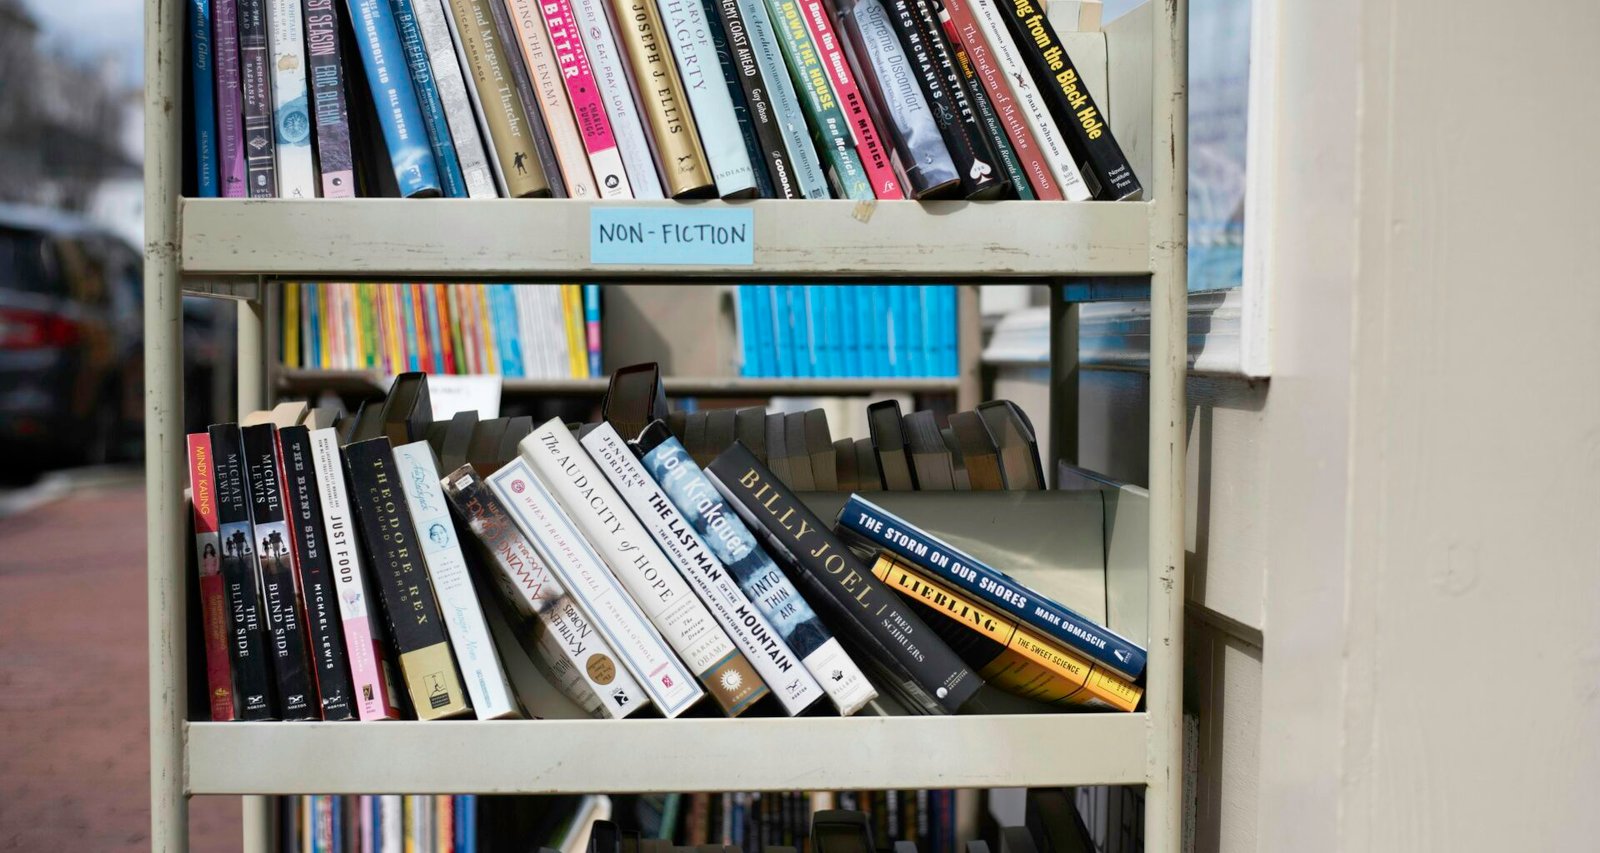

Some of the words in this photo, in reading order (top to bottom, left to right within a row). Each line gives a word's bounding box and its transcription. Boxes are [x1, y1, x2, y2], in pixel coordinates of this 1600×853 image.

[287, 2, 297, 42] WHITAKER
[471, 2, 488, 27] and
[631, 2, 660, 65] JOSEPH
[728, 19, 747, 47] COAST
[962, 22, 980, 44] The
[1023, 11, 1056, 49] from
[307, 14, 336, 56] SEASON
[358, 0, 385, 65] THUNDERBOLT
[376, 66, 389, 84] KID
[398, 13, 430, 85] BATTLEFIELD
[543, 1, 580, 79] BETTER
[594, 42, 609, 64] EAT,
[666, 0, 707, 93] HAGERTY
[694, 27, 709, 49] OF
[752, 13, 775, 61] Armchair
[807, 1, 828, 32] Down
[820, 31, 836, 51] the
[828, 50, 850, 86] House
[195, 42, 208, 70] Glory
[222, 36, 238, 89] RIVER
[466, 36, 487, 82] MARRIAGE
[477, 28, 507, 83] Margaret
[526, 32, 543, 59] THE
[536, 62, 559, 109] ENEMY
[574, 42, 589, 75] FASTER
[737, 46, 756, 77] AHEAD
[781, 0, 806, 41] DOWN
[797, 40, 817, 67] THE
[808, 66, 835, 111] HOUSE
[863, 2, 898, 55] Supreme
[886, 52, 923, 113] Discomfort
[955, 49, 975, 79] Billiards
[971, 44, 1001, 92] Kingdom
[1041, 44, 1069, 73] the
[254, 55, 265, 98] NICHOLAS
[313, 64, 338, 87] ERIC
[601, 65, 618, 93] PRAY,
[651, 68, 666, 83] J.
[749, 87, 764, 102] Guy
[928, 28, 951, 69] FIFTH
[947, 73, 975, 125] STREET
[968, 78, 980, 93] The
[1053, 66, 1090, 110] Black
[315, 90, 341, 126] BLEHM
[386, 88, 400, 107] BILL
[496, 83, 525, 139] Thatcher
[611, 94, 625, 118] LOVE
[657, 86, 682, 135] ELLIS
[755, 100, 770, 124] Gibson
[973, 91, 992, 117] Official
[996, 90, 1009, 103] of
[391, 107, 409, 141] BRYSON
[578, 105, 595, 137] DUHIGG
[587, 100, 605, 136] CHARLES
[845, 91, 862, 116] BEN
[856, 117, 885, 170] MEZRICH
[985, 116, 1000, 136] Rules
[1002, 104, 1030, 149] Matthias
[1024, 91, 1039, 112] Paul
[1038, 120, 1062, 157] Johnson
[1074, 104, 1108, 142] Hole
[825, 116, 841, 136] Ben
[833, 136, 857, 177] Mezrich
[994, 134, 1006, 149] and
[715, 164, 752, 180] INDIANA
[798, 148, 815, 183] CHRISTENSEN
[1000, 147, 1018, 175] Records
[1030, 159, 1050, 190] OXFORD
[1107, 163, 1126, 177] Naval
[1109, 170, 1131, 184] Institute
[1012, 173, 1026, 192] Book
[1115, 177, 1131, 189] Press
[599, 222, 746, 245] NON-FICTION
[195, 445, 207, 477] MINDY
[291, 442, 303, 471] THE
[597, 445, 635, 489] JORDAN
[601, 434, 647, 488] JENNIFER
[197, 478, 210, 515] KALING
[216, 464, 230, 503] LEWIS
[226, 453, 243, 511] MICHAEL
[251, 464, 265, 503] LEWIS
[260, 453, 278, 511] MICHAEL
[296, 475, 311, 520] BLIND
[654, 440, 694, 481] Jon
[680, 473, 755, 560] Krakauer
[330, 514, 346, 546] JUST
[462, 492, 506, 544] GRACE
[538, 430, 564, 458] The
[556, 452, 625, 538] AUDACITY
[615, 535, 640, 561] of
[631, 552, 675, 604] HOPE
[304, 524, 317, 559] SIDE
[369, 487, 390, 541] EDMUND
[387, 550, 408, 603] MORRIS
[372, 457, 412, 574] THEODORE
[408, 585, 427, 625] REX
[524, 494, 547, 522] WHEN
[543, 520, 583, 570] TRUMPETS
[580, 569, 600, 592] CALL
[737, 465, 816, 546] BILLY
[808, 537, 880, 611] JOEL
[336, 549, 353, 583] FOOD
[494, 535, 548, 604] AMAZING
[856, 511, 884, 534] THE
[883, 525, 929, 558] STORM
[928, 549, 950, 569] ON
[949, 560, 977, 583] OUR
[977, 575, 1028, 610] SHORES
[645, 491, 673, 521] THE
[666, 517, 698, 553] LAST
[692, 550, 722, 584] MAN
[718, 582, 728, 592] ON
[725, 591, 738, 605] THE
[733, 603, 793, 674] MOUNTAIN
[657, 528, 670, 543] THE
[667, 541, 683, 559] DEATH
[680, 558, 689, 567] OF
[686, 565, 695, 575] AN
[692, 573, 717, 603] AMERICAN
[714, 601, 745, 638] ADVENTURER
[741, 636, 751, 646] ON
[748, 644, 757, 654] K2
[749, 569, 781, 598] INTO
[763, 586, 790, 610] THIN
[230, 583, 245, 623] BLIND
[244, 605, 257, 631] THE
[268, 583, 283, 623] BLIND
[282, 605, 295, 631] THE
[560, 600, 593, 639] NORRIS
[682, 615, 694, 626] The
[777, 601, 797, 620] AIR
[897, 572, 999, 634] LIEBLING
[313, 583, 327, 631] MICHAEL
[321, 635, 334, 670] LEWIS
[544, 603, 587, 657] KATHLEEN
[604, 599, 632, 634] PATRICIA
[628, 632, 655, 664] O'TOOLE
[678, 616, 705, 638] American
[686, 624, 706, 641] Dream
[880, 617, 926, 664] SCHRUERS
[888, 609, 914, 636] FRED
[1033, 606, 1061, 626] MARK
[1060, 619, 1107, 650] OBMASCIK
[236, 627, 249, 658] SIDE
[274, 627, 287, 658] SIDE
[690, 633, 720, 657] BARACK
[695, 640, 728, 668] OBAMA
[1016, 636, 1031, 649] THE
[1027, 642, 1053, 661] SWEET
[1050, 654, 1081, 676] SCIENCE
